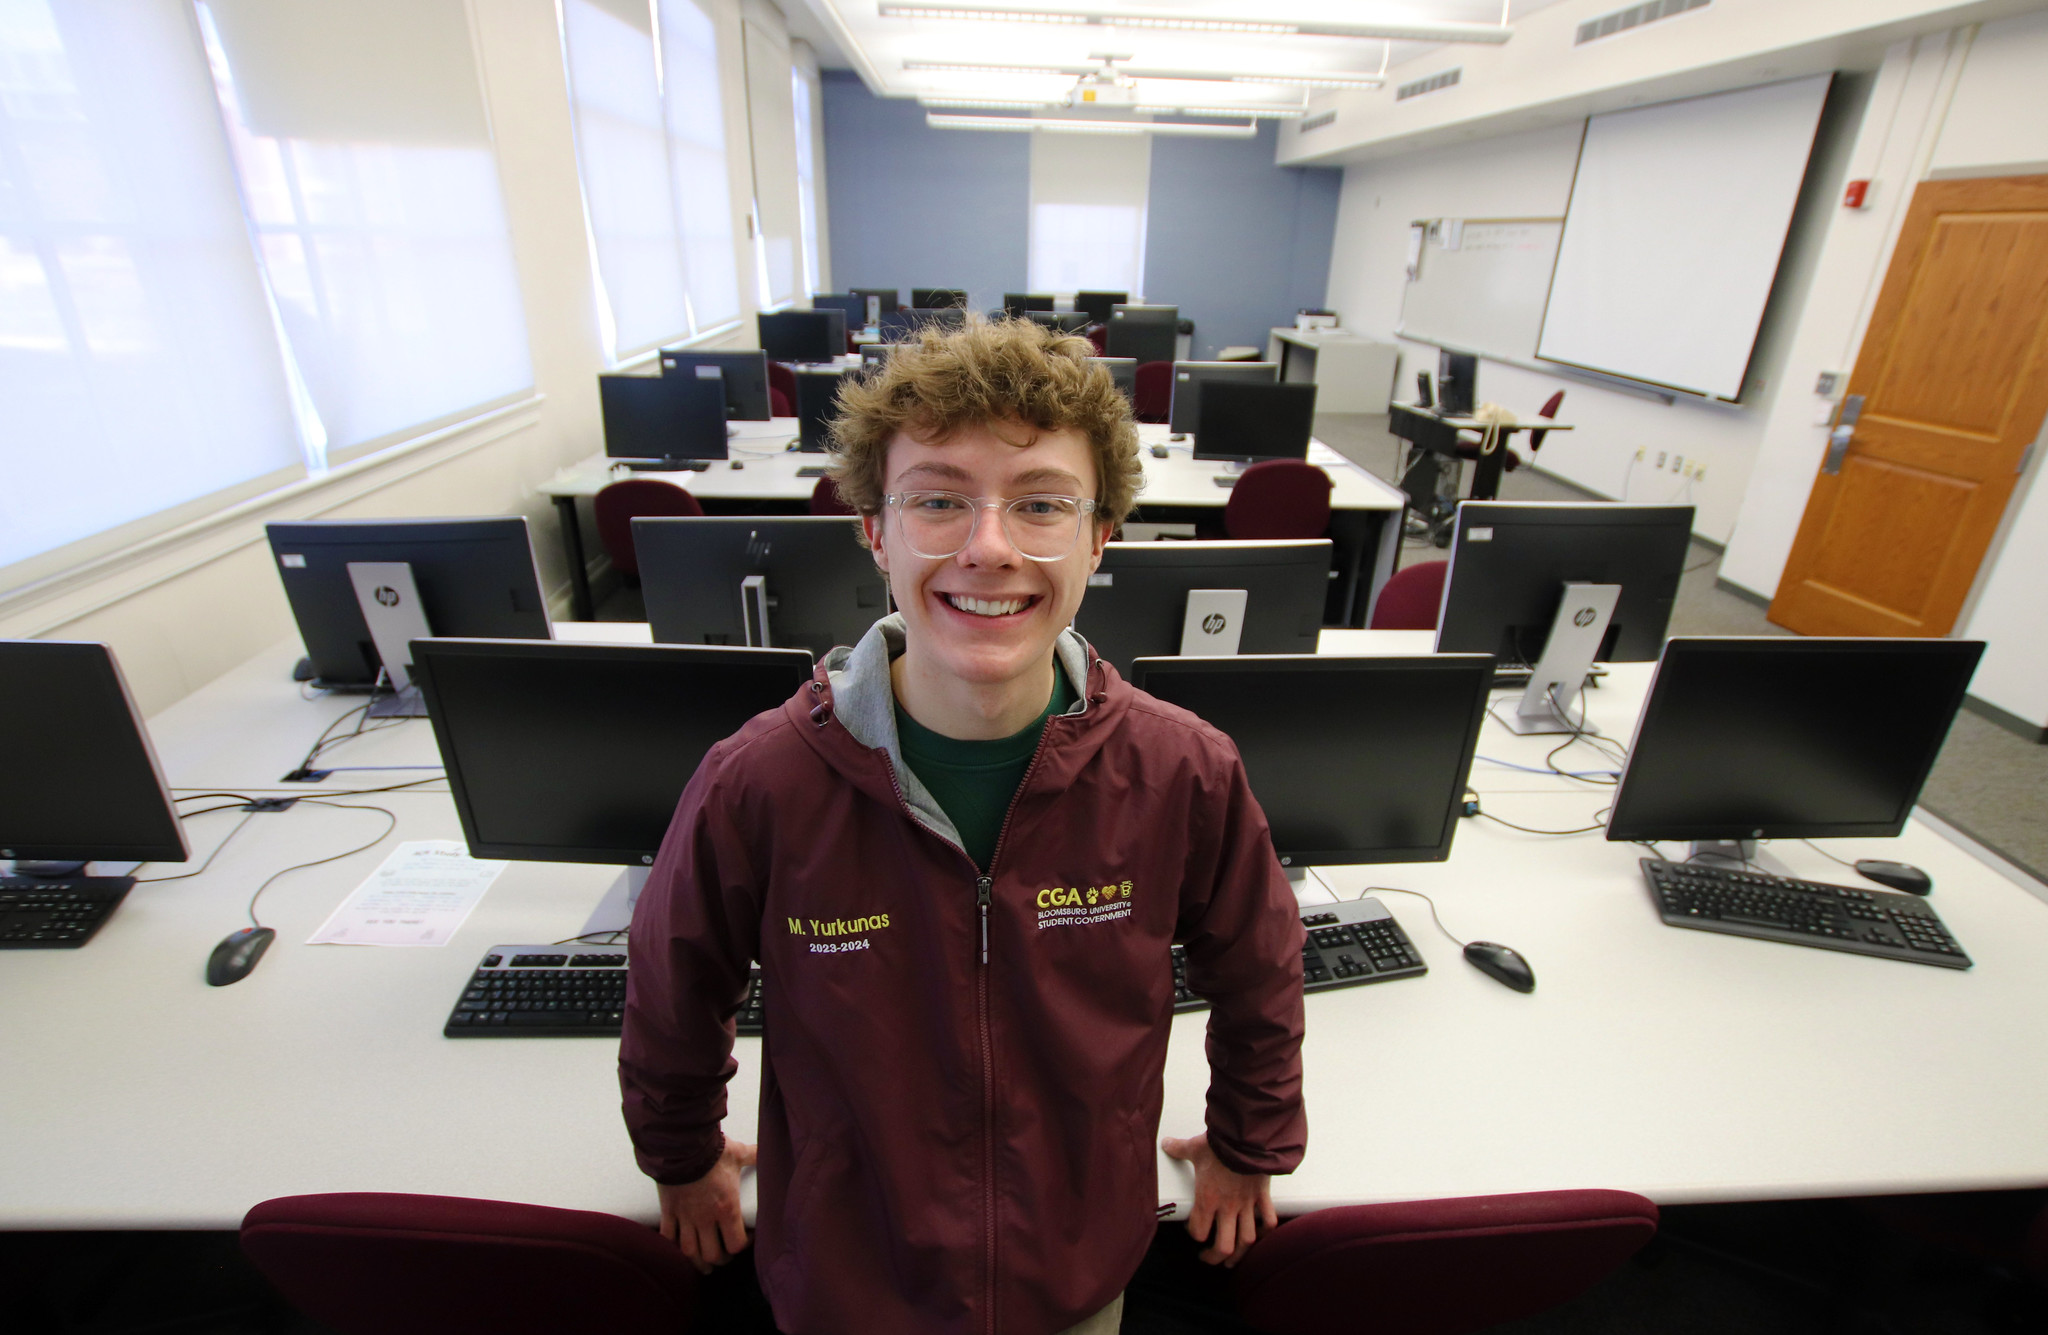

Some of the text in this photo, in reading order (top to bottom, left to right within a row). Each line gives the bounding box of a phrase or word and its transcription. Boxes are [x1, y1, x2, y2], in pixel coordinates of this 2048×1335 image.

[374, 586, 396, 607] hp
[1204, 613, 1225, 635] hp
[1574, 606, 1596, 628] hp
[1037, 888, 1083, 908] CGA
[1038, 907, 1087, 919] BLOOMSBURG
[1038, 909, 1131, 929] STUDENT GOVERNMENT
[787, 913, 890, 937] M. Yurkunas
[809, 938, 870, 953] 2023-2024
